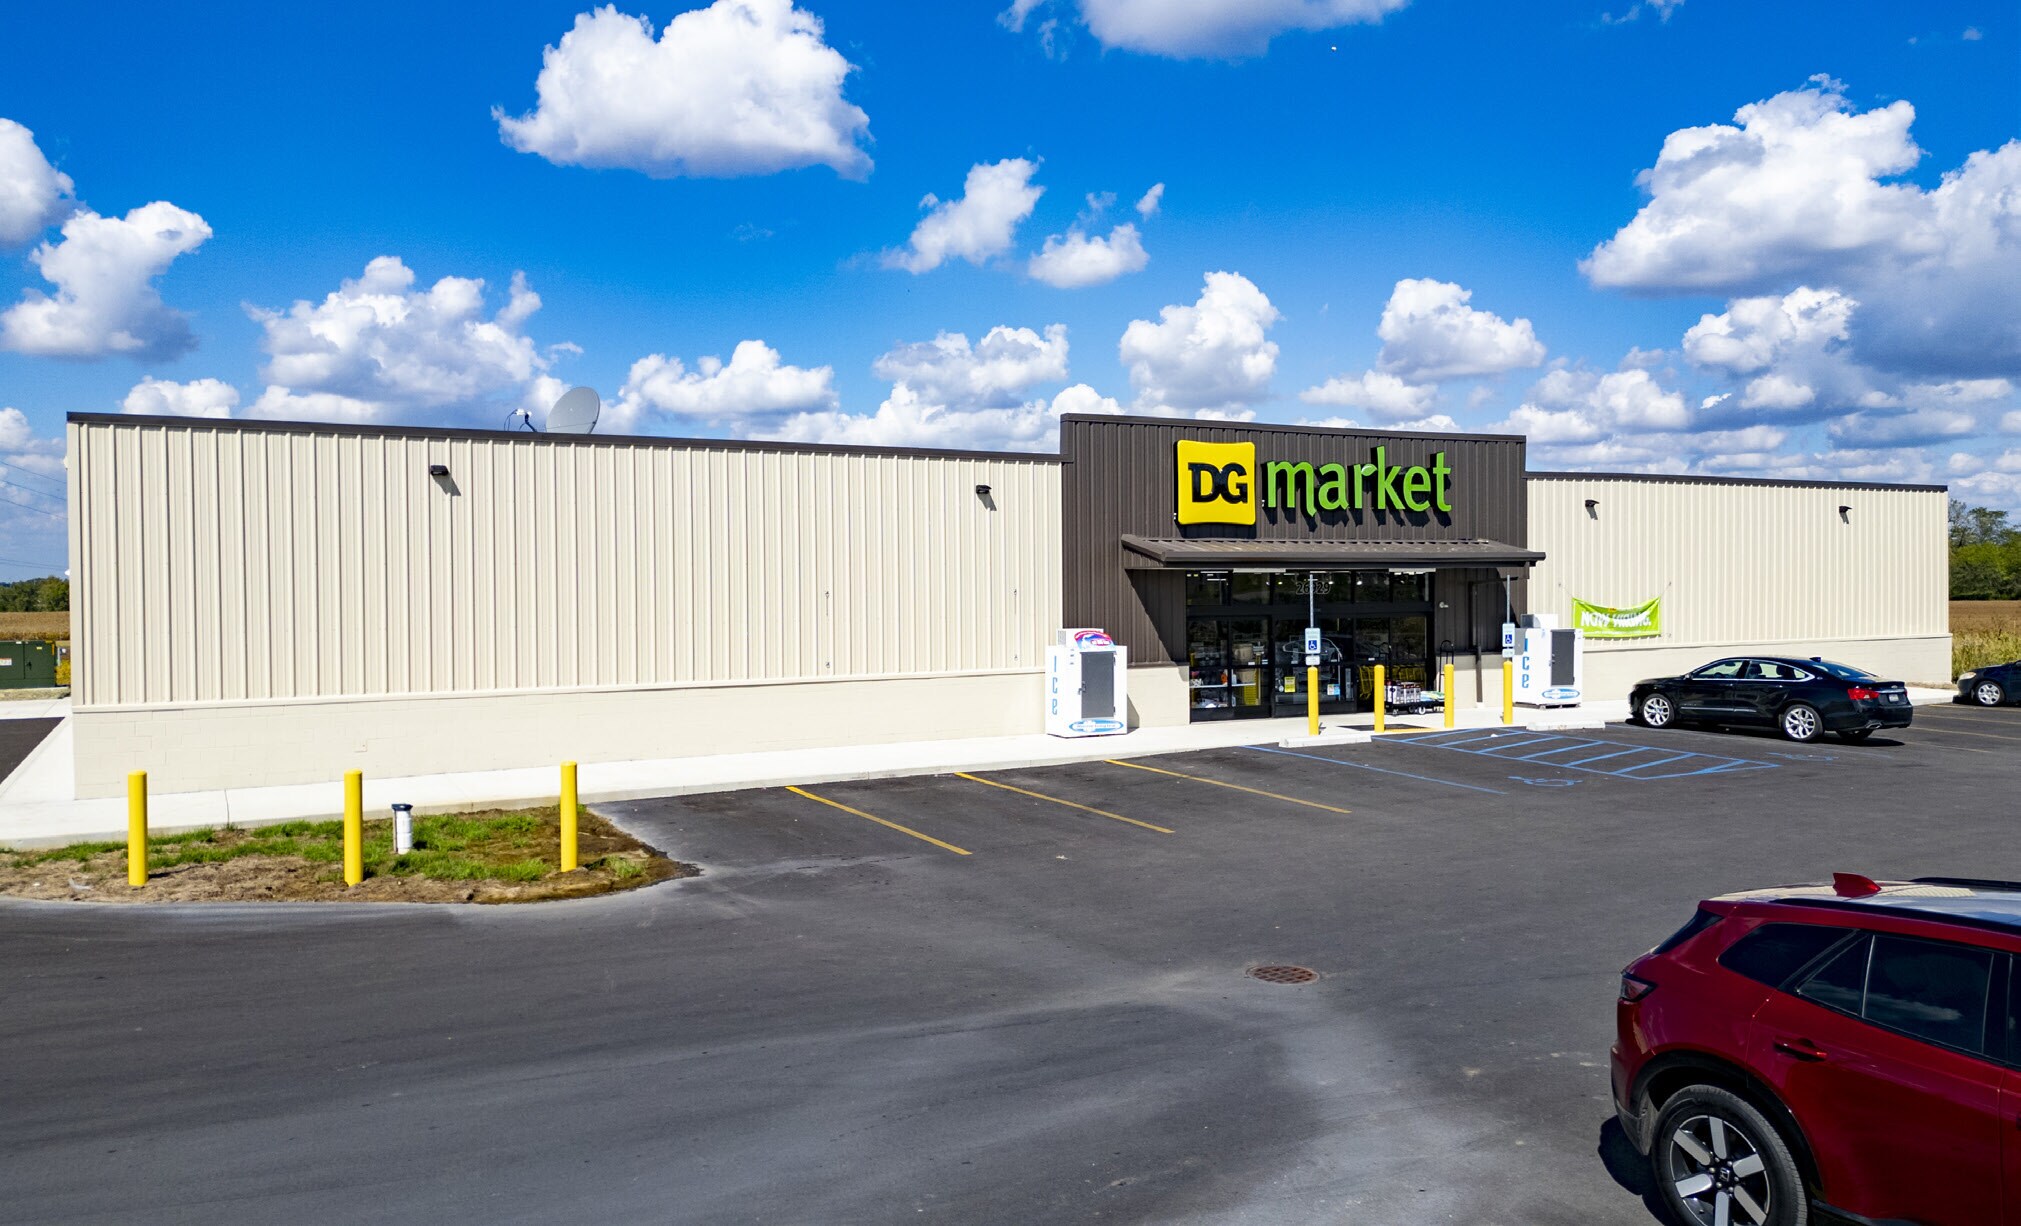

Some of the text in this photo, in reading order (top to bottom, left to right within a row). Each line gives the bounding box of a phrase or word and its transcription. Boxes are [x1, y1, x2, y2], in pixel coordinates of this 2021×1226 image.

[1188, 446, 1452, 517] DG market
[1581, 611, 1609, 627] NOW
